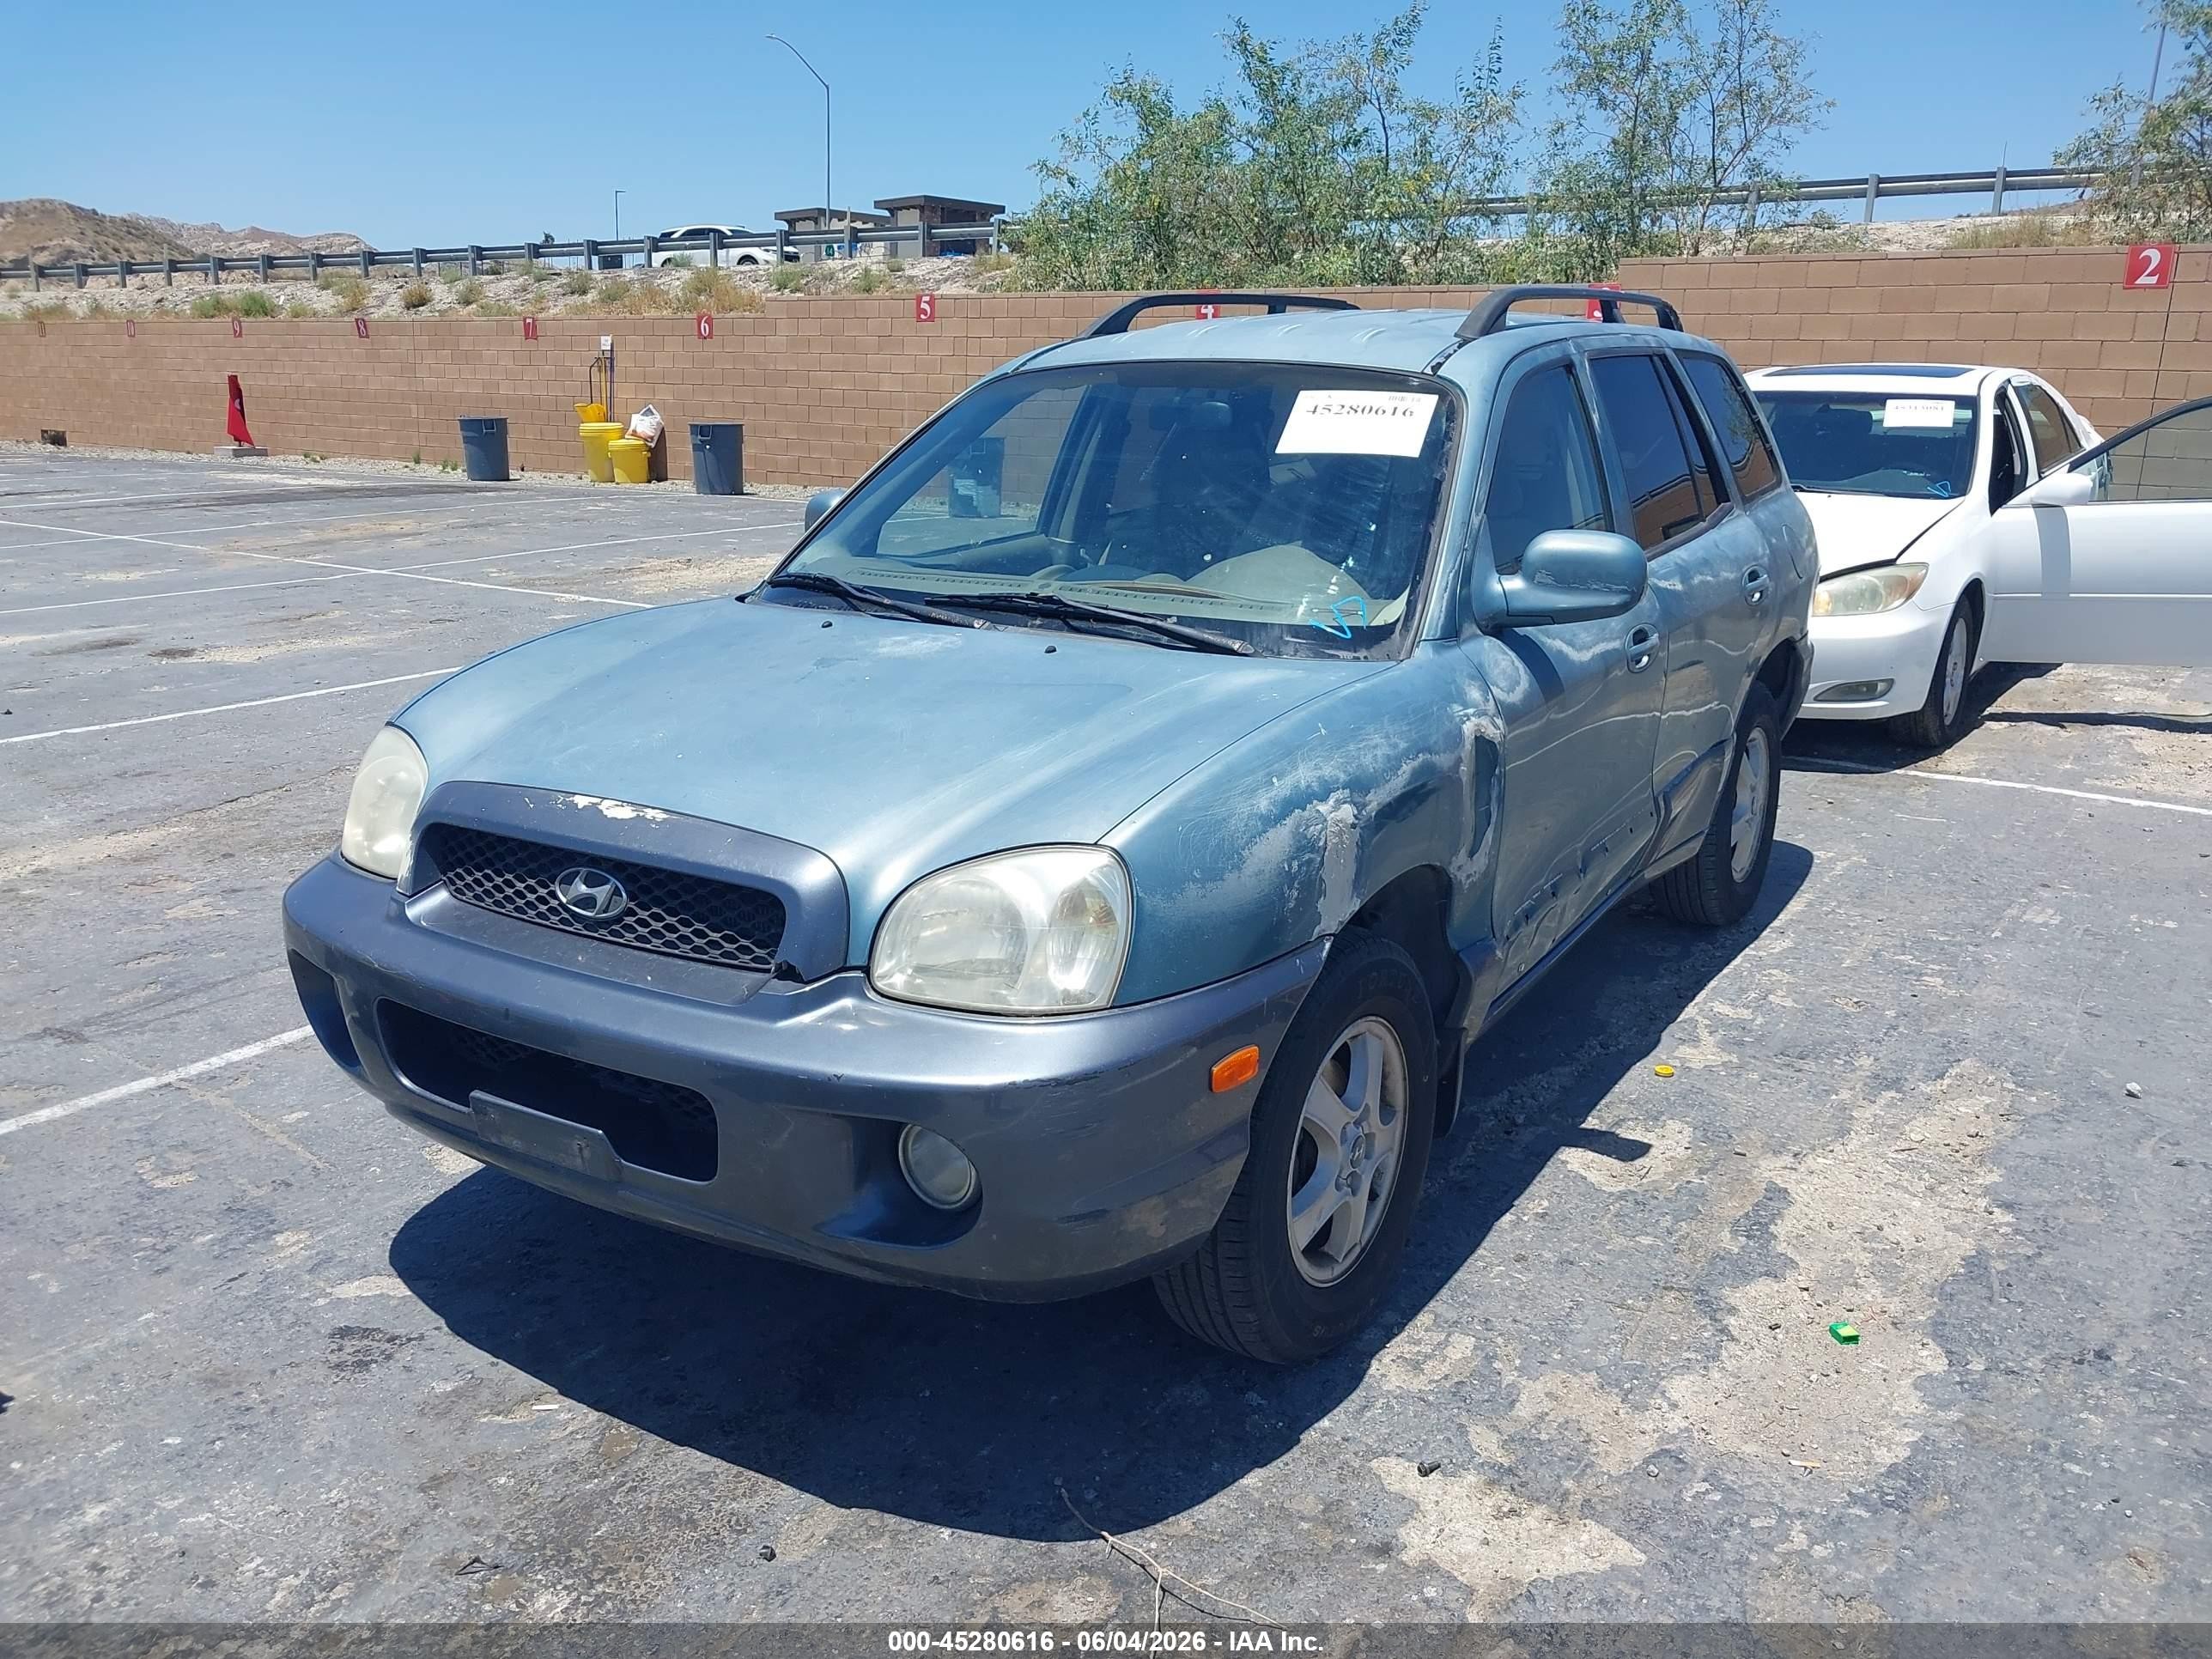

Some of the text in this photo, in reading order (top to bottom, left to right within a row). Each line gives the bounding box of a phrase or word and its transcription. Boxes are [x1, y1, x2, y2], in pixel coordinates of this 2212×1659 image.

[2134, 248, 2161, 284] 2
[920, 295, 931, 319] 5
[234, 320, 240, 337] 9
[357, 319, 367, 337] 8
[526, 318, 533, 337] 7
[700, 315, 709, 337] 6
[1306, 404, 1415, 417] 45280616
